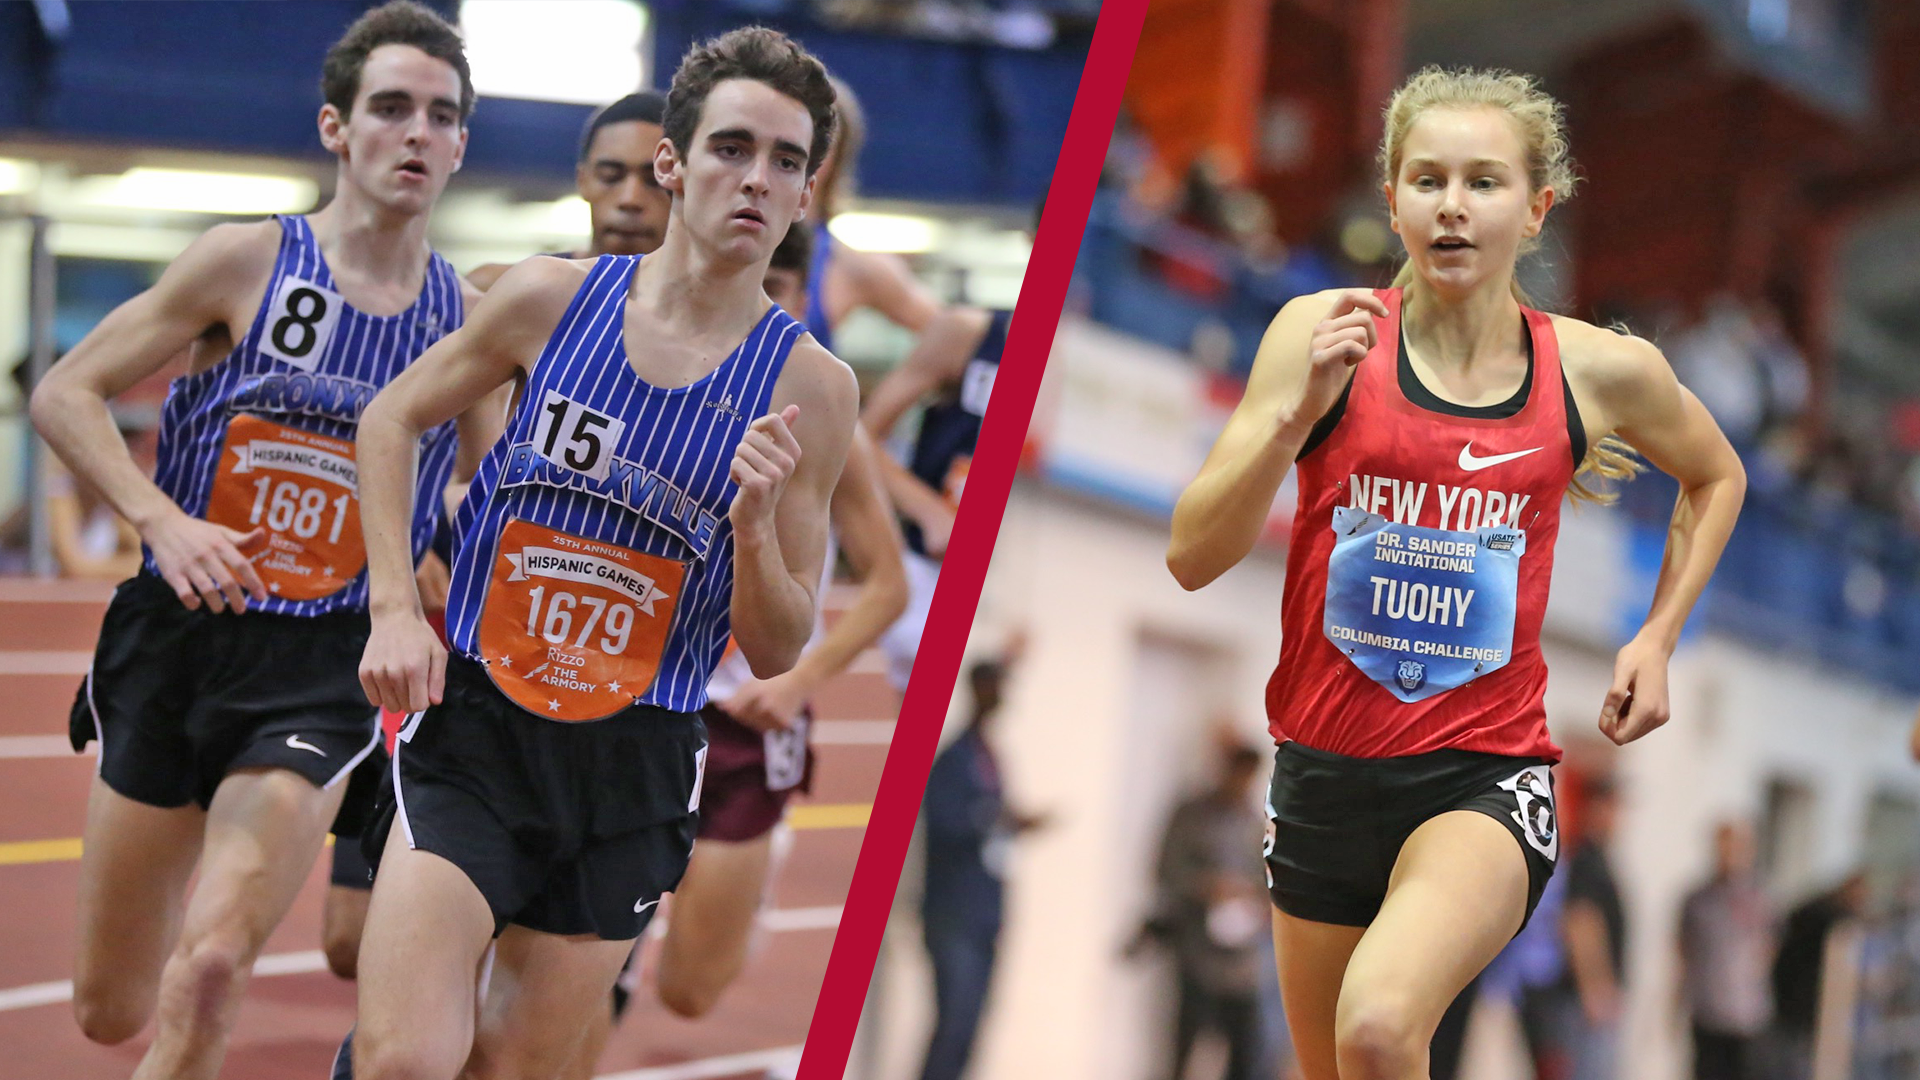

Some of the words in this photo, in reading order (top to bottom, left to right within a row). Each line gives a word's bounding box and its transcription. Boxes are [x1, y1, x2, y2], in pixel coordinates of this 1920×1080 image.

[271, 287, 327, 358] 8
[308, 437, 351, 454] ANNUAL
[544, 399, 611, 472] 15
[253, 449, 317, 467] HISPANIC
[248, 475, 349, 545] 1681
[1349, 473, 1428, 526] NEW
[1437, 484, 1531, 533] YORK
[552, 535, 580, 549] 25TH
[582, 543, 630, 561] ANNUAL
[1376, 531, 1404, 549] DR.
[1407, 536, 1477, 558] SANDER
[1491, 533, 1516, 542] USATF
[261, 558, 313, 576] ARMORY
[1374, 546, 1476, 574] INVITATIONAL
[527, 556, 594, 575] HISPANIC
[596, 565, 646, 597] GAMES
[1369, 575, 1476, 628] TUOHY
[526, 585, 636, 656] 1679
[1330, 625, 1411, 653] COLUMBIA
[1413, 640, 1504, 663] CHALLENGE
[540, 674, 597, 693] ARMORY
[553, 666, 579, 680] THE
